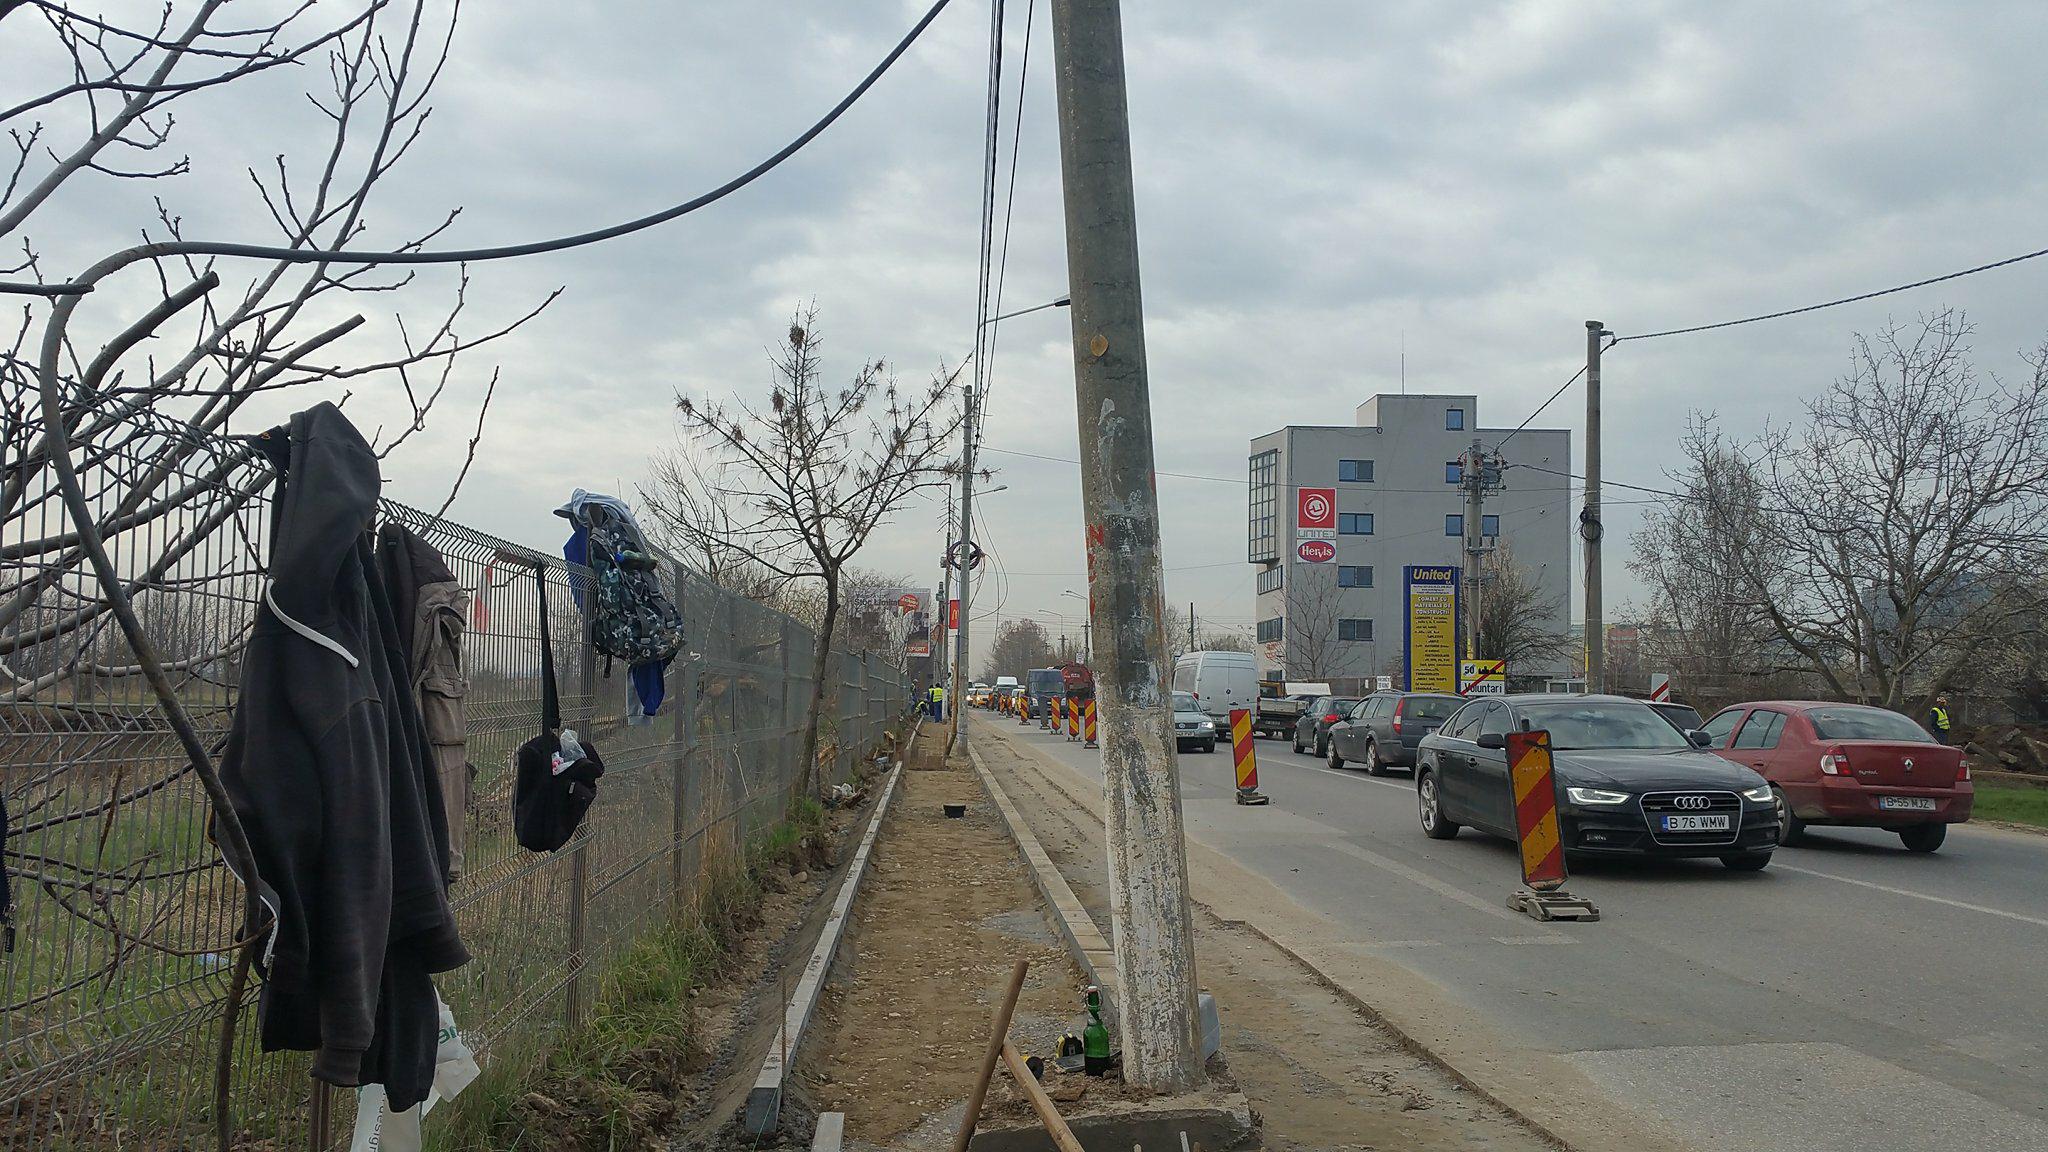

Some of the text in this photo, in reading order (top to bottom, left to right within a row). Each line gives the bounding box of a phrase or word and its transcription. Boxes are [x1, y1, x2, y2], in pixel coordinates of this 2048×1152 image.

[1298, 529, 1335, 538] UNITED
[1302, 545, 1332, 558] Hervis
[1413, 568, 1452, 581] United
[1464, 665, 1475, 675] 50
[1464, 683, 1502, 693] Voluntari
[1886, 797, 1895, 807] B
[1897, 797, 1909, 808] 55
[1669, 816, 1726, 829] B 76 WMW
